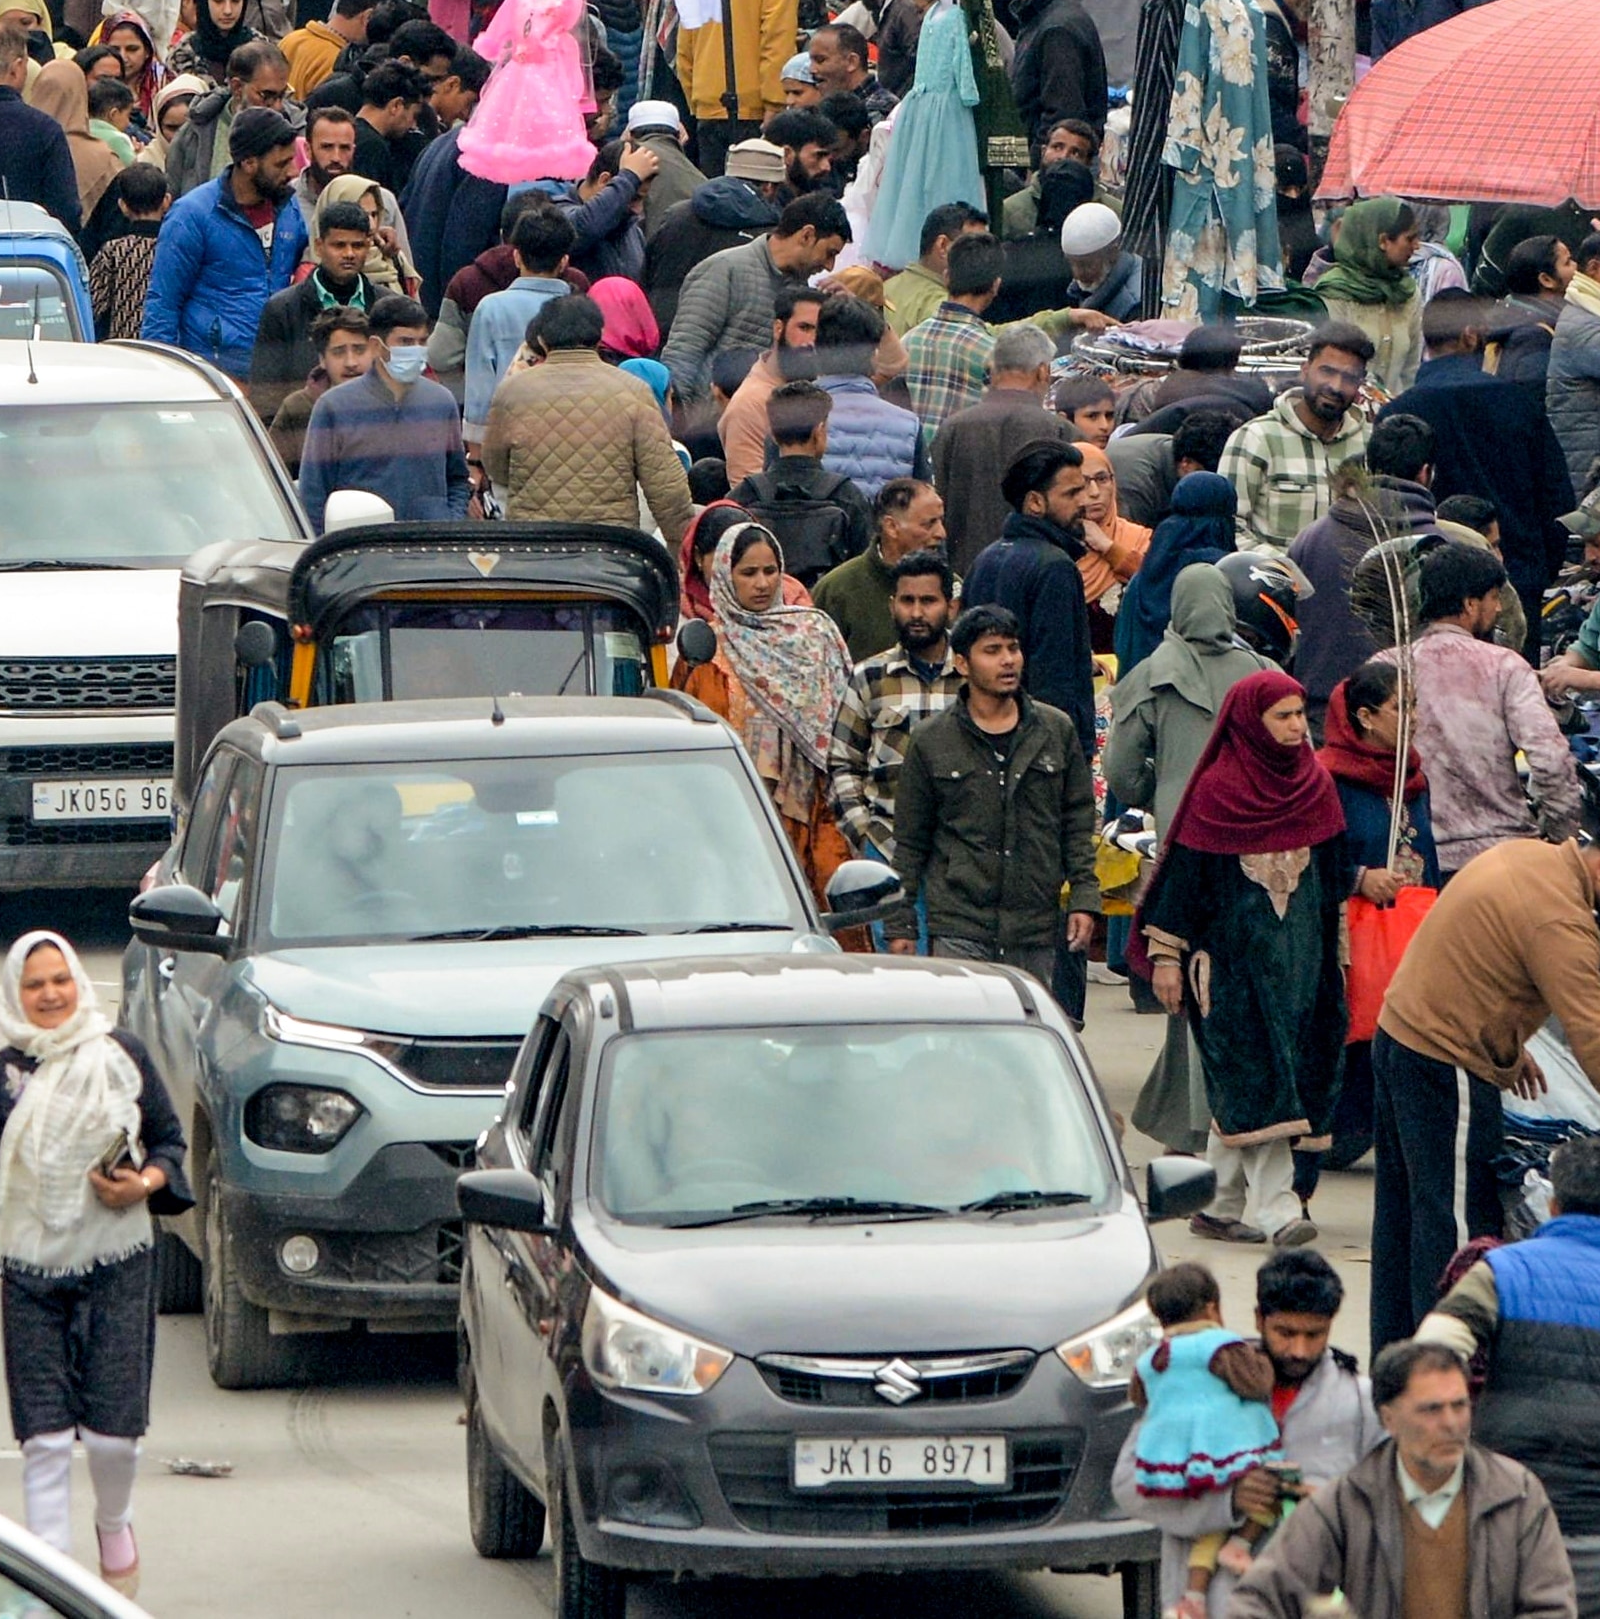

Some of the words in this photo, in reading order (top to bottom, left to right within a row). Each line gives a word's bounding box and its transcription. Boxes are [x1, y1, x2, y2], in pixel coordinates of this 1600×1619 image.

[44, 788, 126, 814] JK05G
[820, 1444, 892, 1475] JK16
[922, 1443, 994, 1475] 8971
